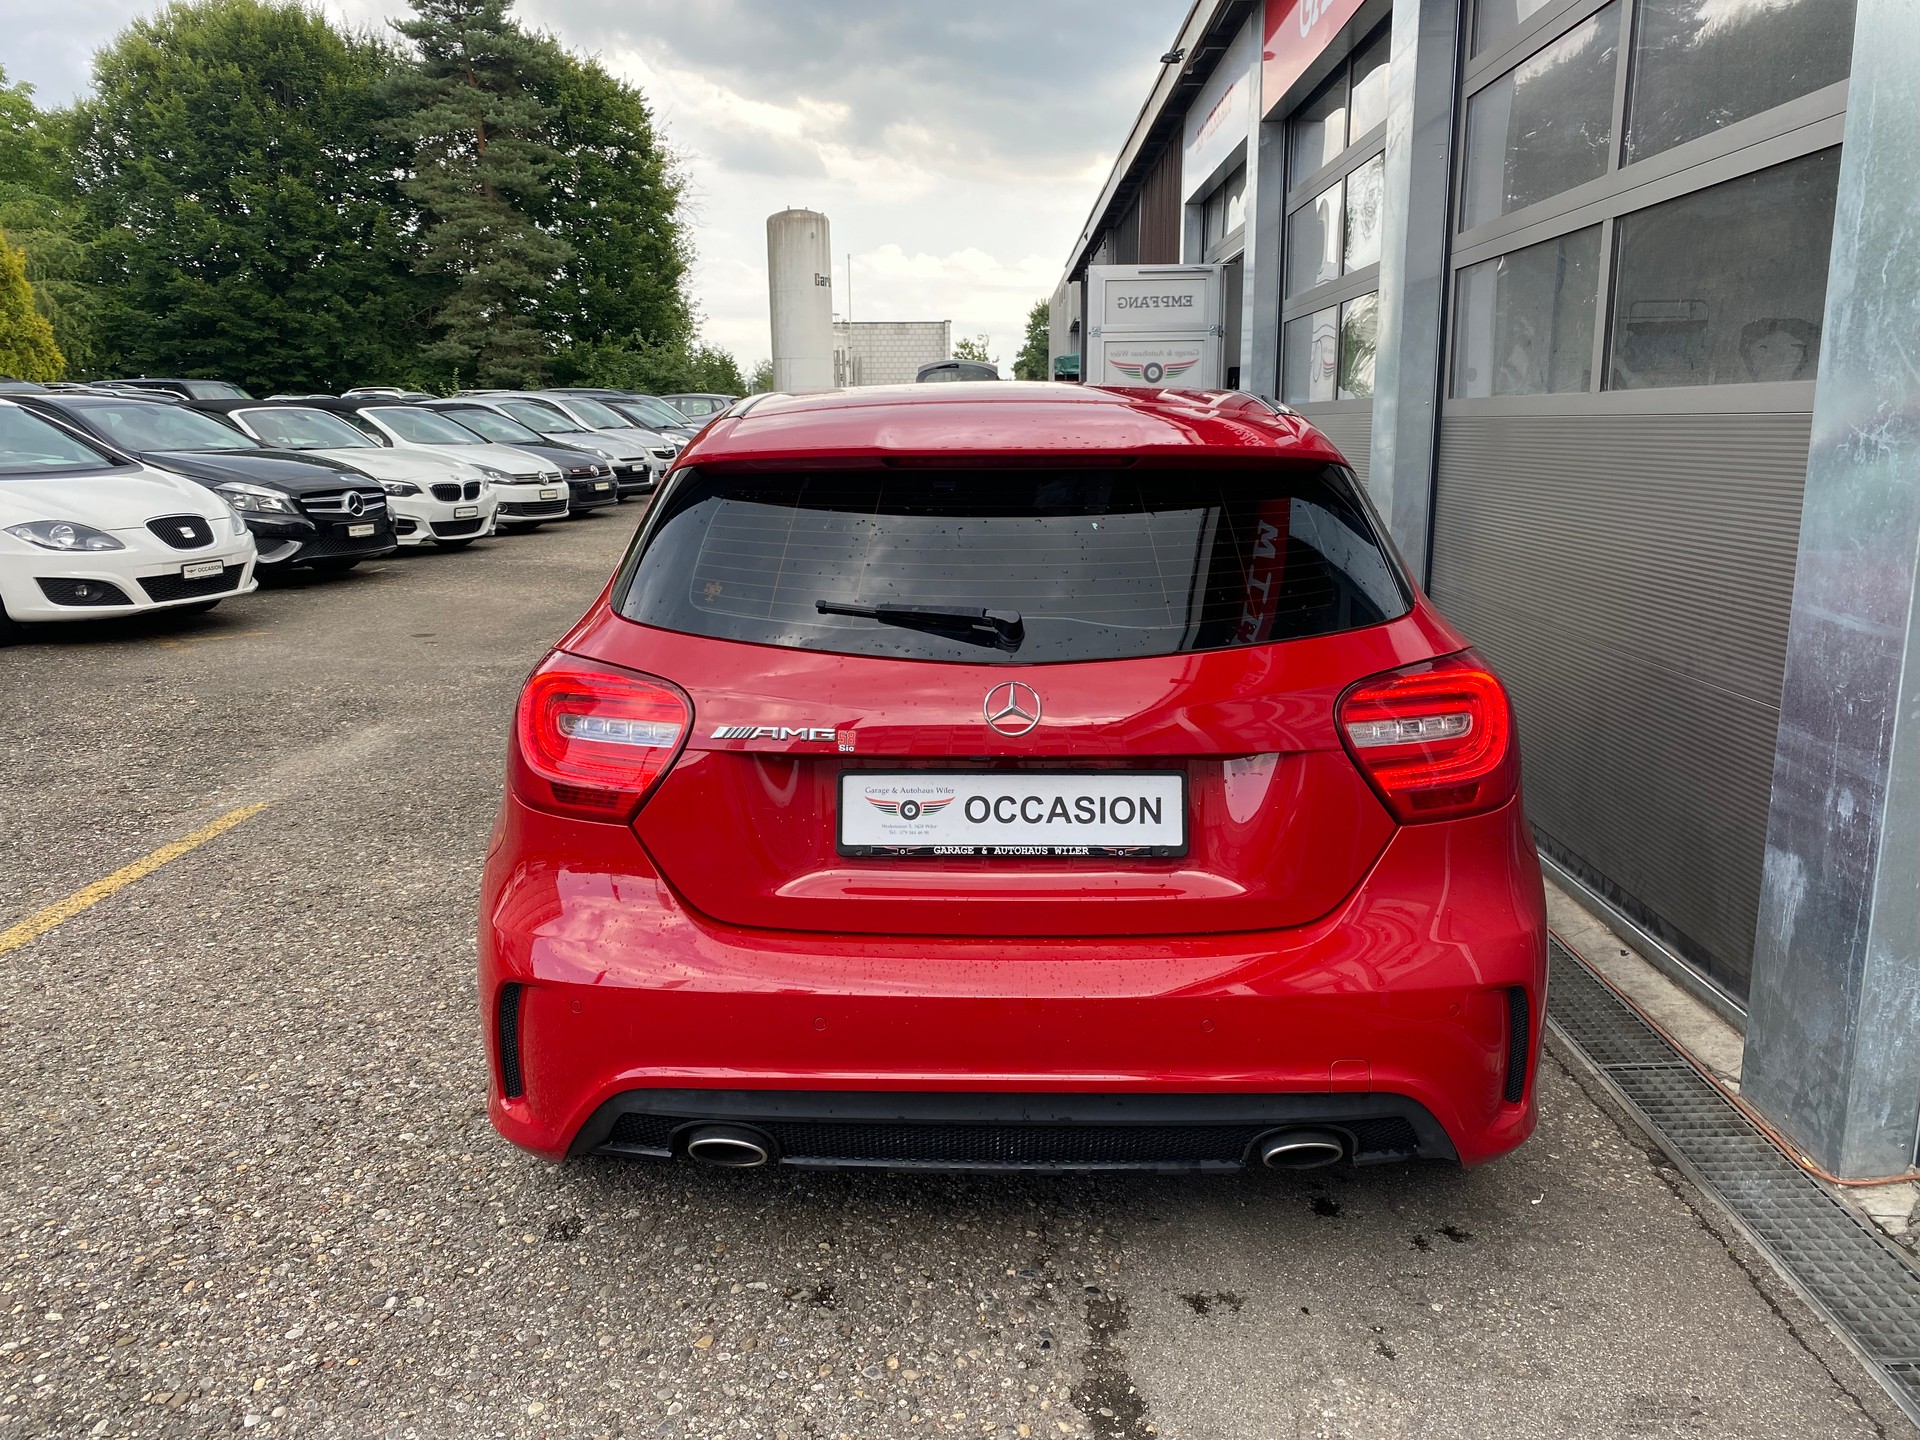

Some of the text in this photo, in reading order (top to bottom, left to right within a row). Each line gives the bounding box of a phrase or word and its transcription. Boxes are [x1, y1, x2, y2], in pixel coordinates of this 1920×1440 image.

[198, 564, 221, 573] OCCASION
[750, 726, 836, 741] AMG
[864, 786, 955, 795] Garage & Autohaus Wiler
[964, 795, 1162, 824] OCCASION
[933, 846, 1090, 855] GARAGE & AUTOHAUS WILER
